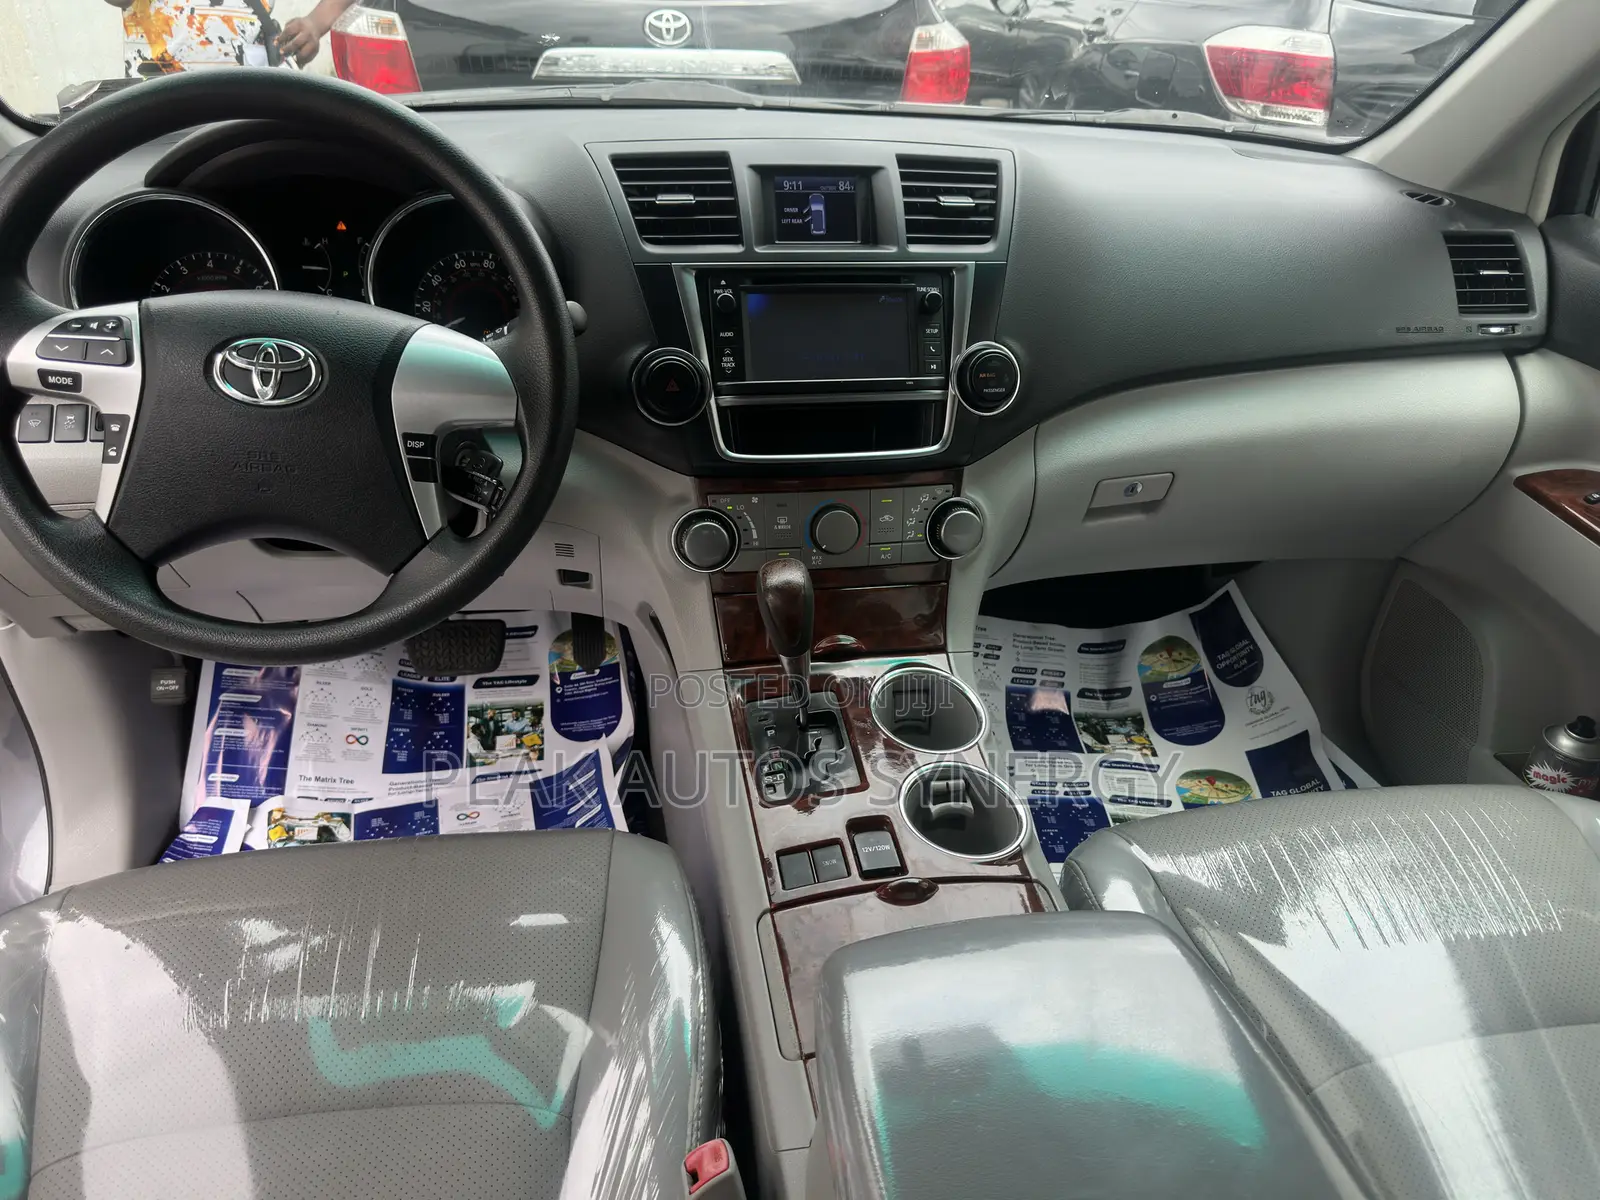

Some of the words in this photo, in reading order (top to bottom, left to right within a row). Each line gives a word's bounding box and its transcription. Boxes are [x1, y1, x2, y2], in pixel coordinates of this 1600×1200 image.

[783, 180, 803, 190] 9:11
[206, 260, 214, 268] 4
[454, 260, 466, 270] 60
[482, 260, 496, 270] 80
[180, 266, 188, 275] 3
[234, 266, 241, 274] 5
[431, 274, 442, 287] 40
[161, 284, 171, 293] 2
[422, 300, 431, 312] 20
[48, 376, 74, 386] MODE
[406, 440, 425, 448] DISP
[400, 672, 422, 680] LEADER
[504, 678, 528, 686] Lifestyle
[298, 774, 312, 782] The
[315, 776, 337, 784] Matrix
[1532, 770, 1568, 784] magic
[1288, 778, 1320, 794] GLOBAL
[862, 844, 891, 852] 12V/120W
